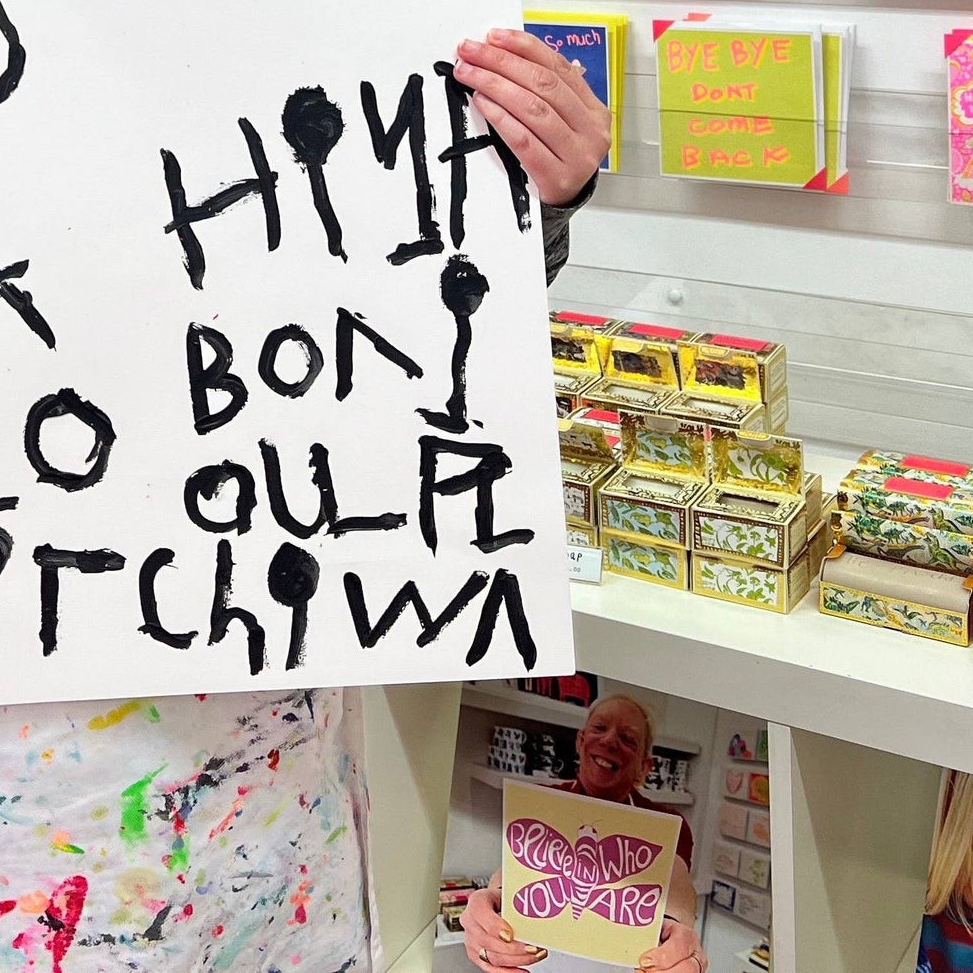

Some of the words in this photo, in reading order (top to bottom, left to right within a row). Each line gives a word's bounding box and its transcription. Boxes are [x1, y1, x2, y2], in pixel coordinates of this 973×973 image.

[544, 35, 564, 52] So
[566, 29, 601, 47] much
[667, 39, 720, 75] BYE
[730, 36, 791, 69] BYE
[691, 82, 757, 104] DONT
[688, 114, 775, 136] COME
[681, 144, 791, 170] BACK
[599, 837, 653, 881] Who
[515, 877, 572, 918] YOU
